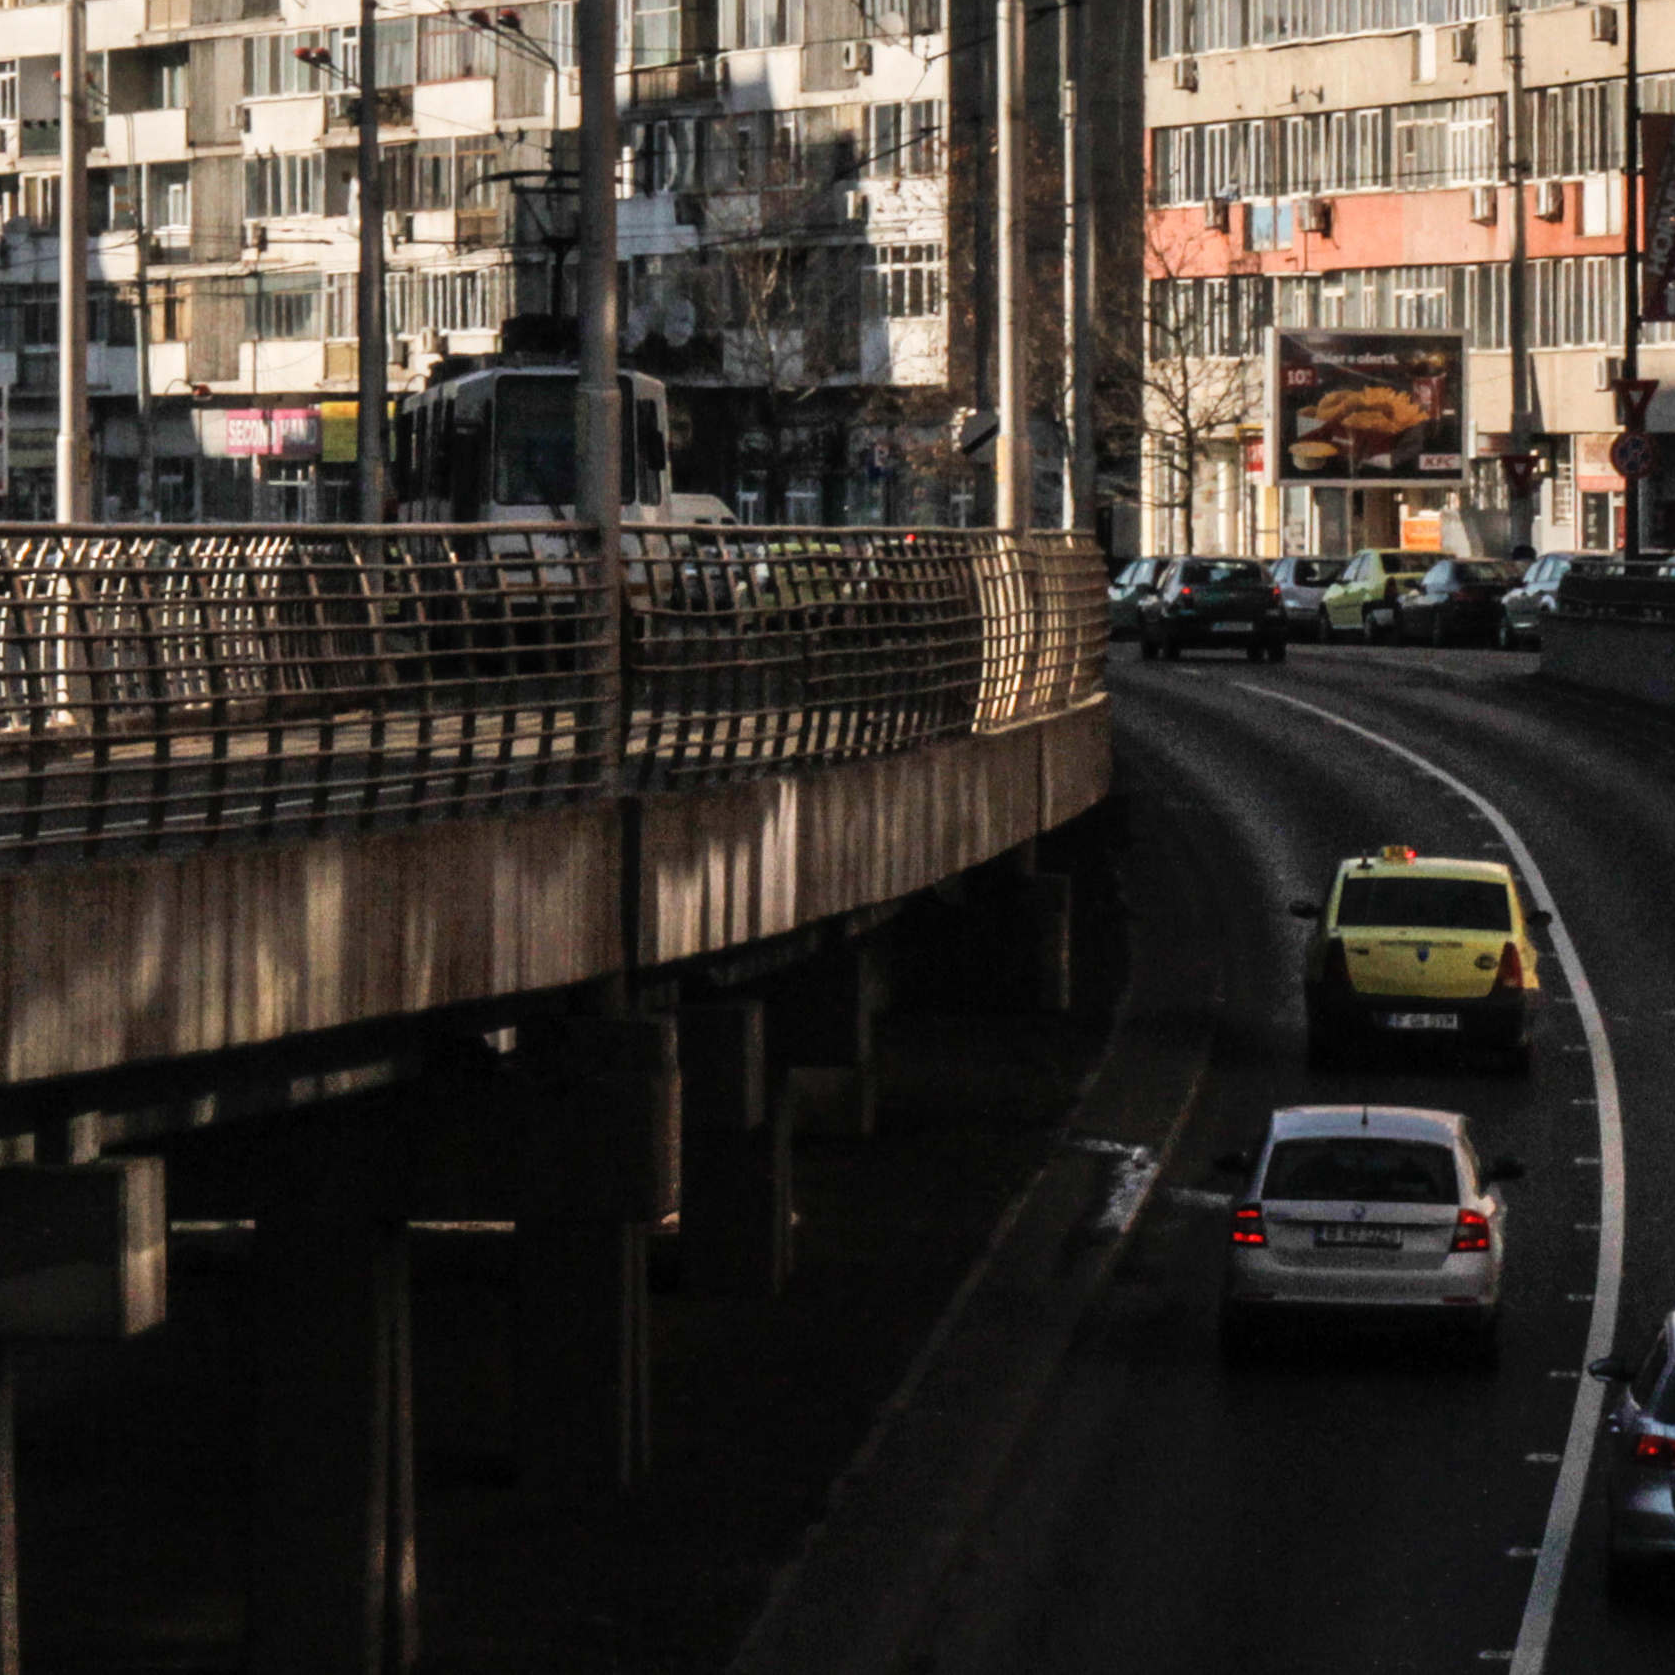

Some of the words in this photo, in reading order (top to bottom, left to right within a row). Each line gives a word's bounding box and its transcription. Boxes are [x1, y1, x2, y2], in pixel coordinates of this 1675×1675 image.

[228, 419, 278, 447] SECOND
[281, 418, 318, 446] HAND
[1424, 456, 1456, 467] KFC
